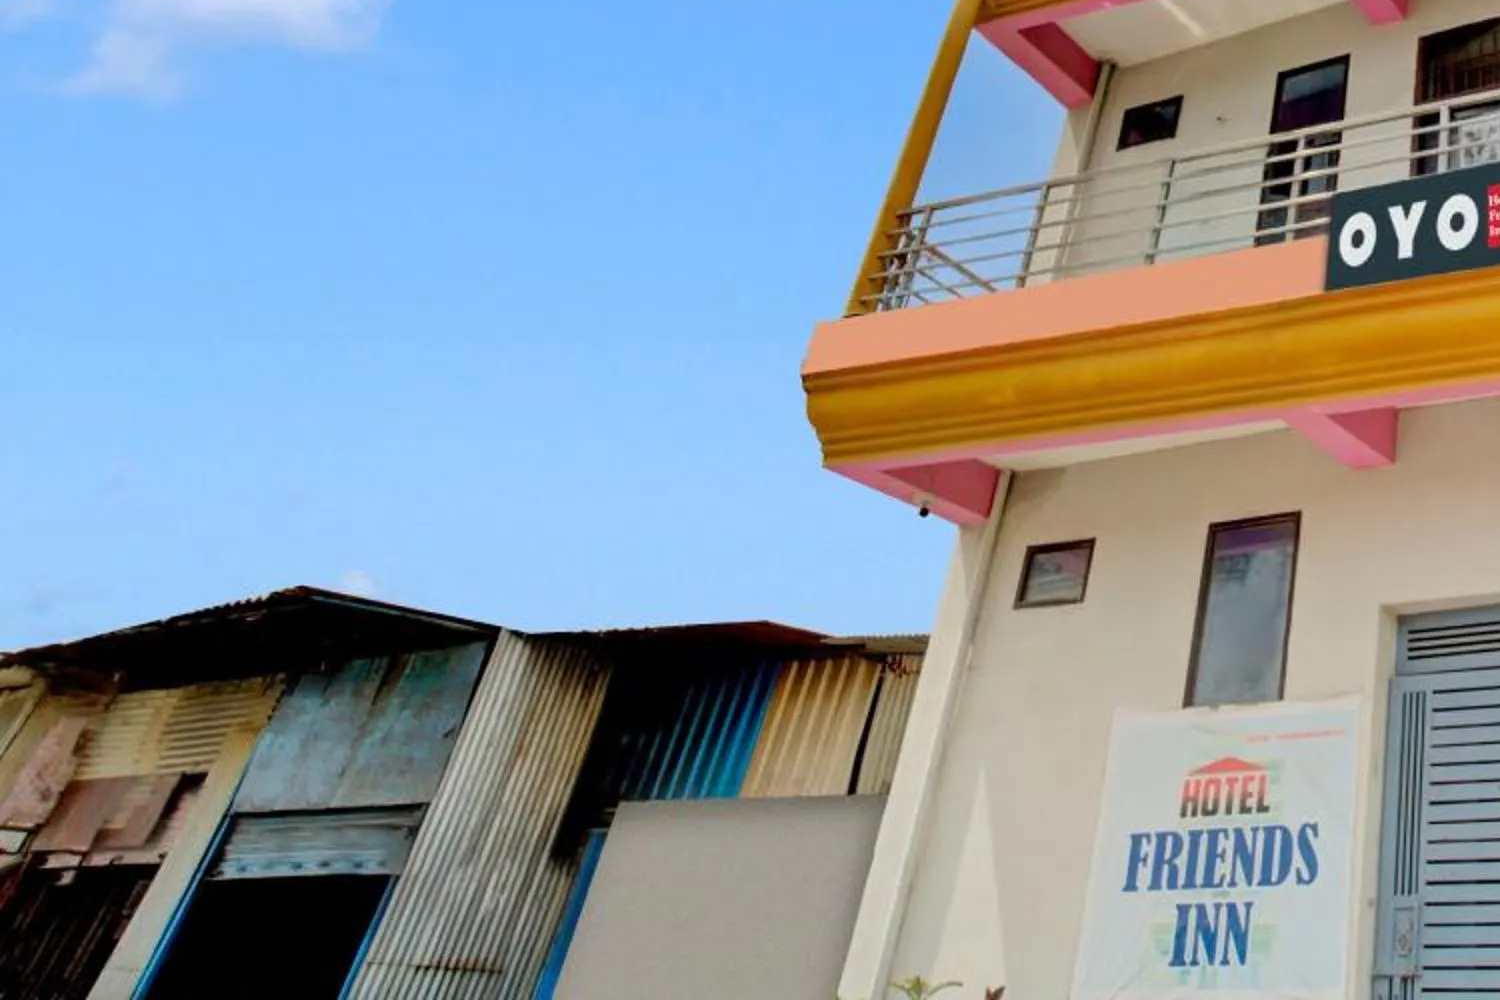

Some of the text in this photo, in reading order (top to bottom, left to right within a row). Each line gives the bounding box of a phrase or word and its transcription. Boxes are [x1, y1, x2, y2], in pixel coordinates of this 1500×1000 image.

[1339, 194, 1479, 267] OYO
[1180, 774, 1270, 818] HOTEL
[1121, 822, 1319, 892] FRIENDS
[1168, 901, 1254, 967] INN
